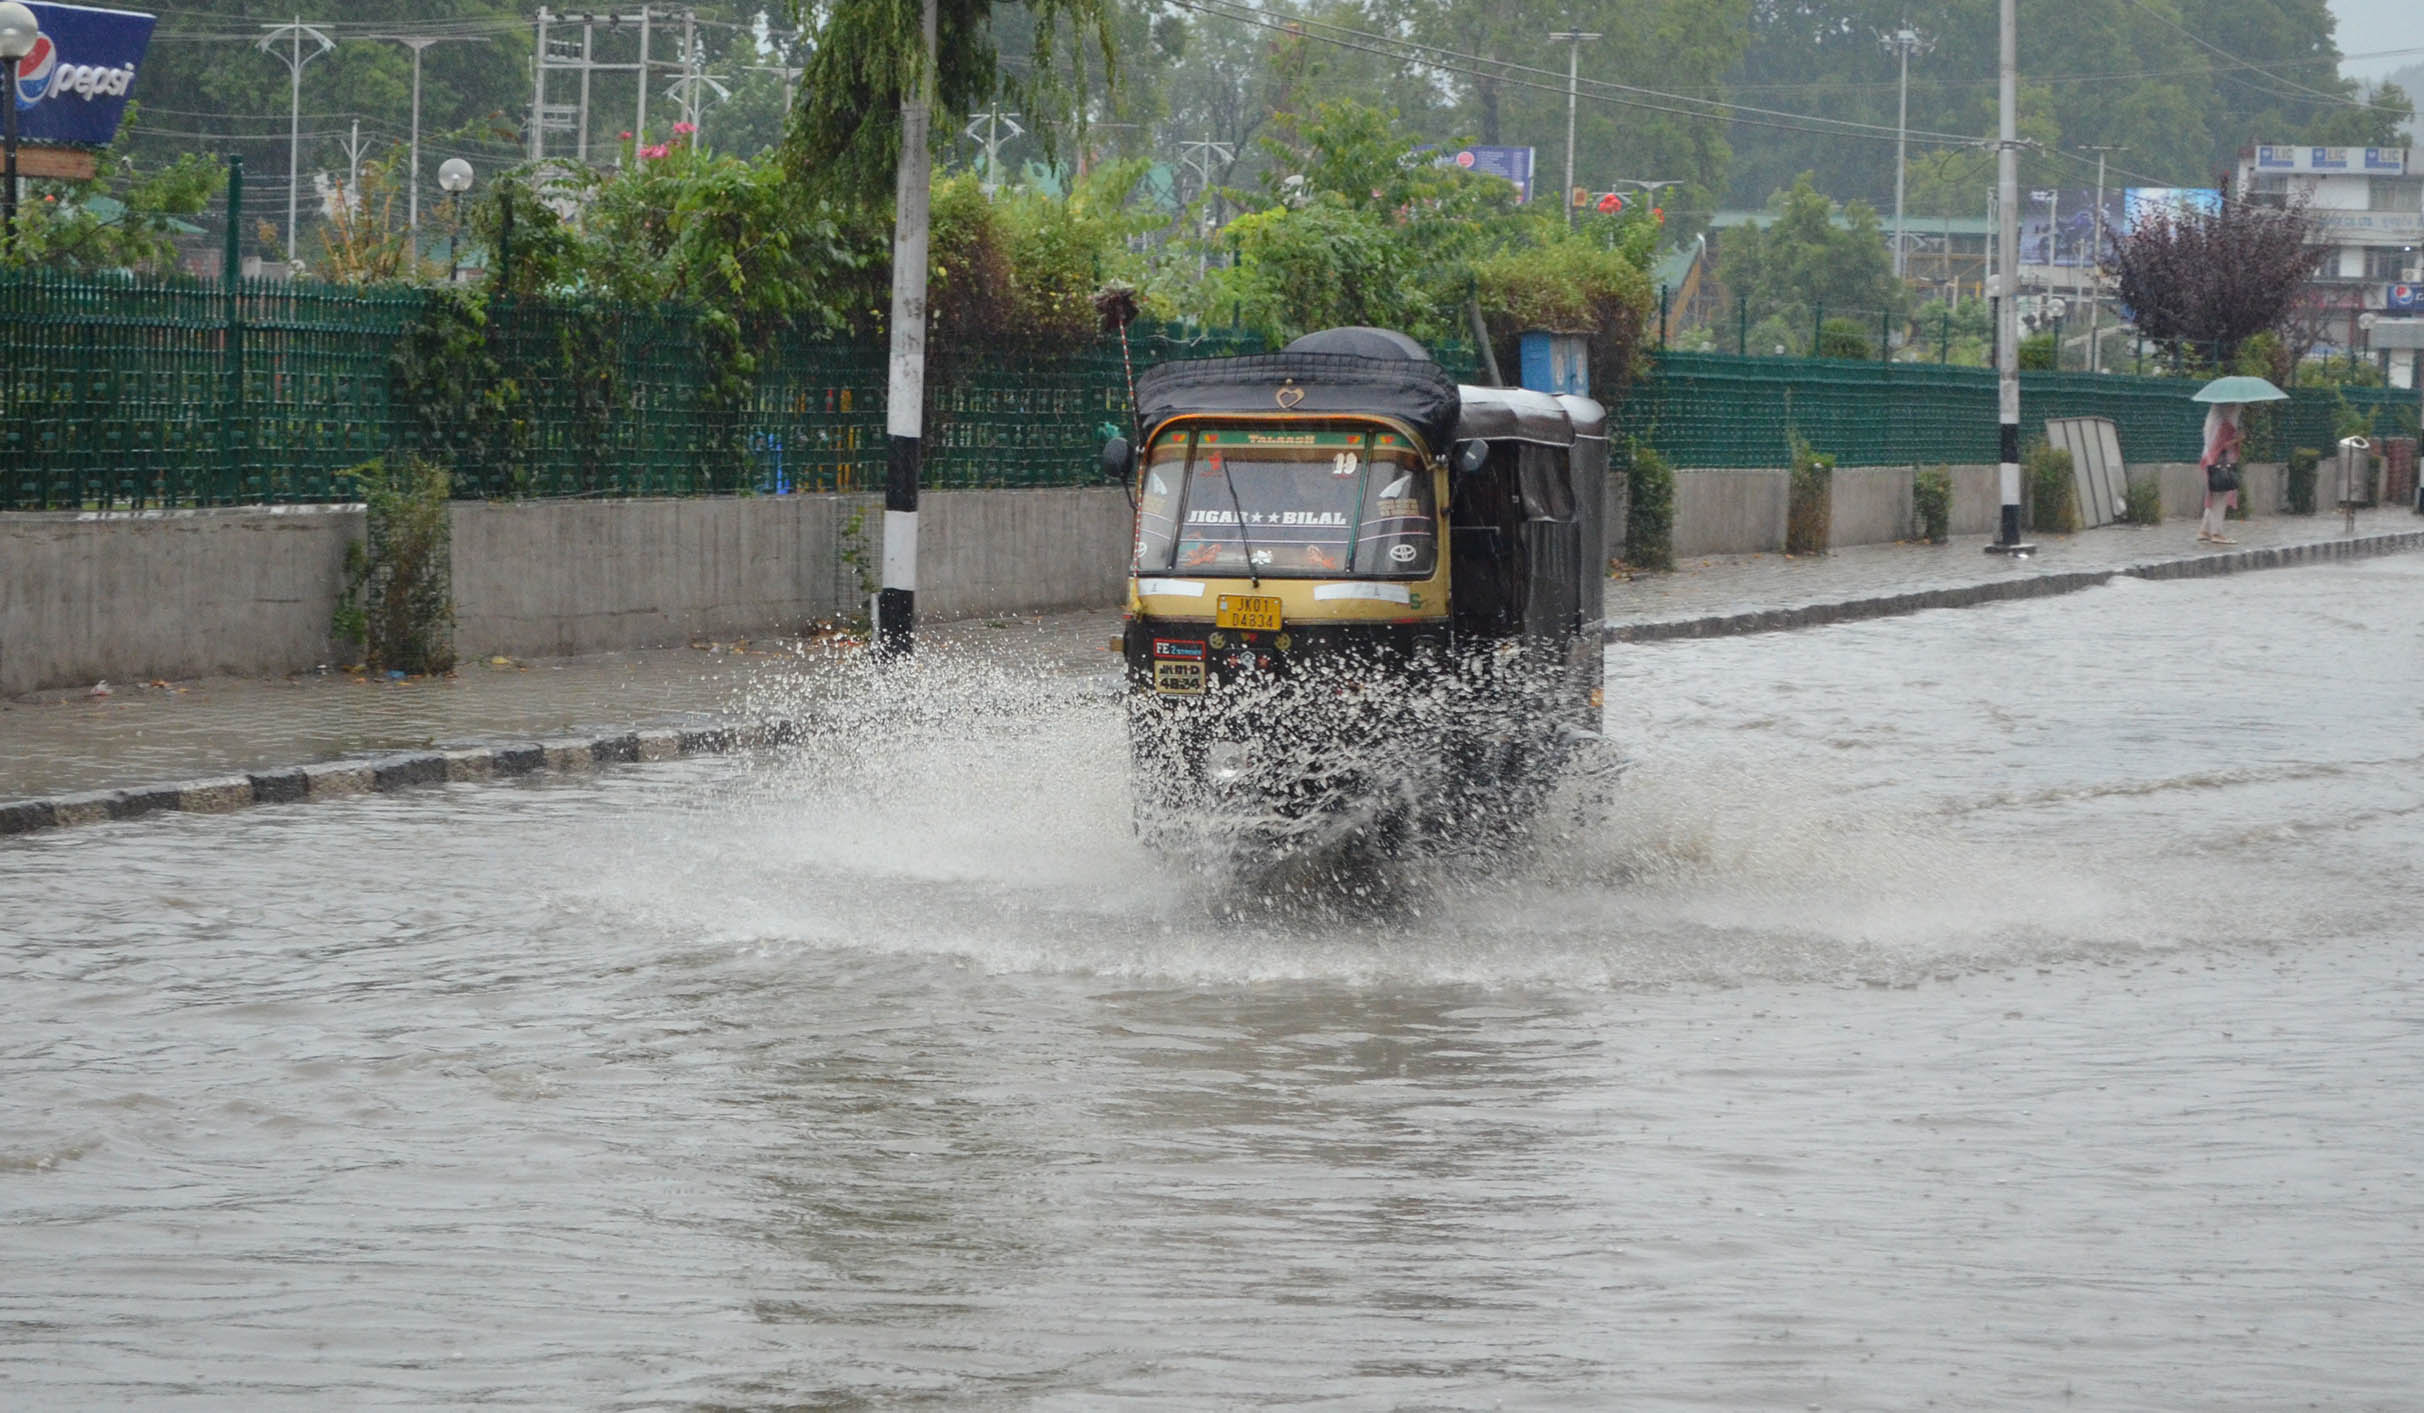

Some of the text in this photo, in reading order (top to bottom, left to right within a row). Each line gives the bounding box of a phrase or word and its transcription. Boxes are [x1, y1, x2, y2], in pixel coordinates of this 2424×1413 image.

[47, 62, 135, 102] pepsi
[2275, 149, 2294, 160] LIC
[2327, 149, 2347, 161] LIC
[2380, 149, 2400, 162] LIC
[1188, 510, 1347, 525] JIGAR BILAL
